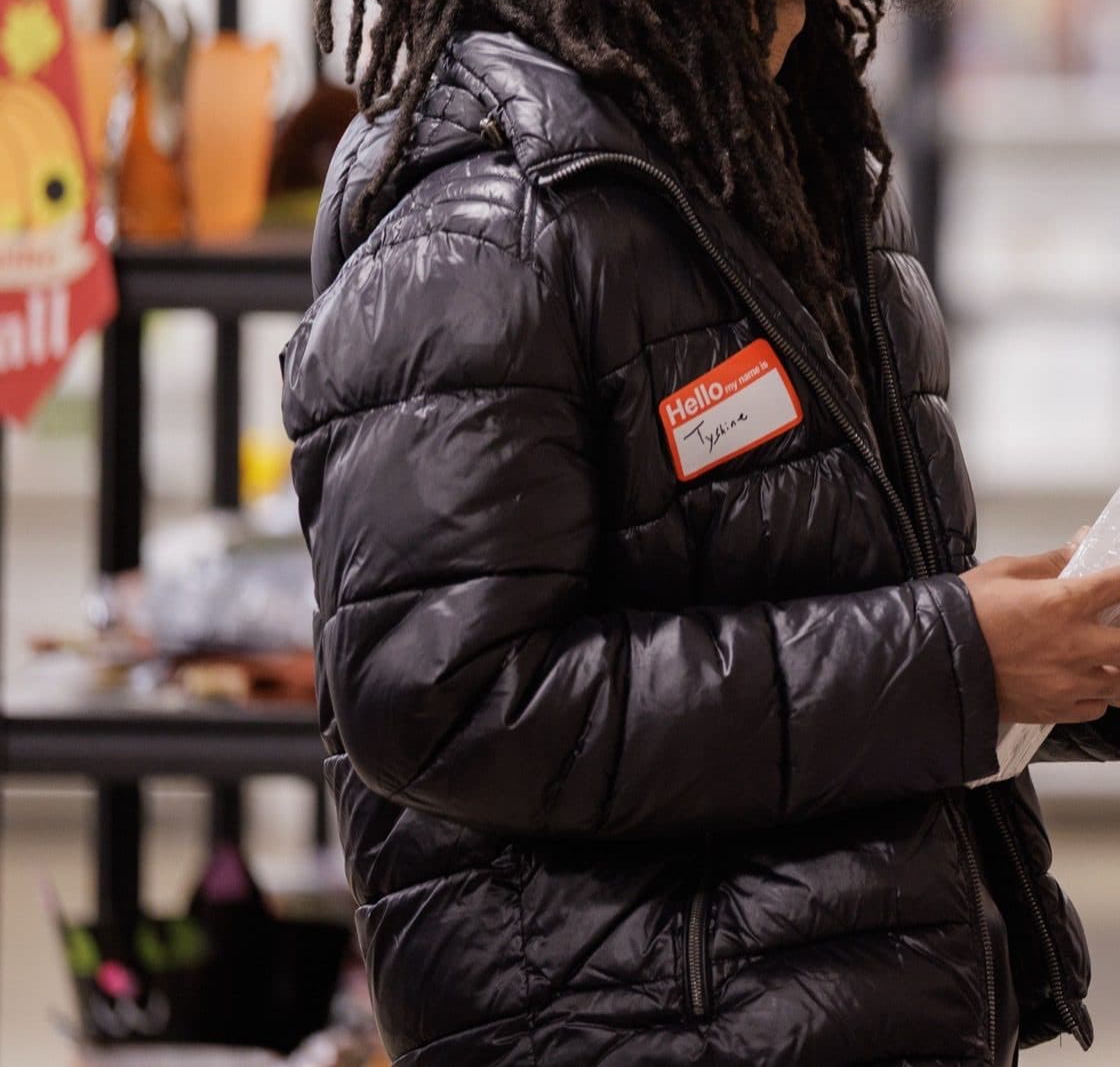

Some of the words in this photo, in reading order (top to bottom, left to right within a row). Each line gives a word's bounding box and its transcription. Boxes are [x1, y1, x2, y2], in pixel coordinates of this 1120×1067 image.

[665, 382, 723, 426] Hello
[724, 381, 738, 394] my
[738, 367, 761, 385] name
[759, 360, 769, 370] is
